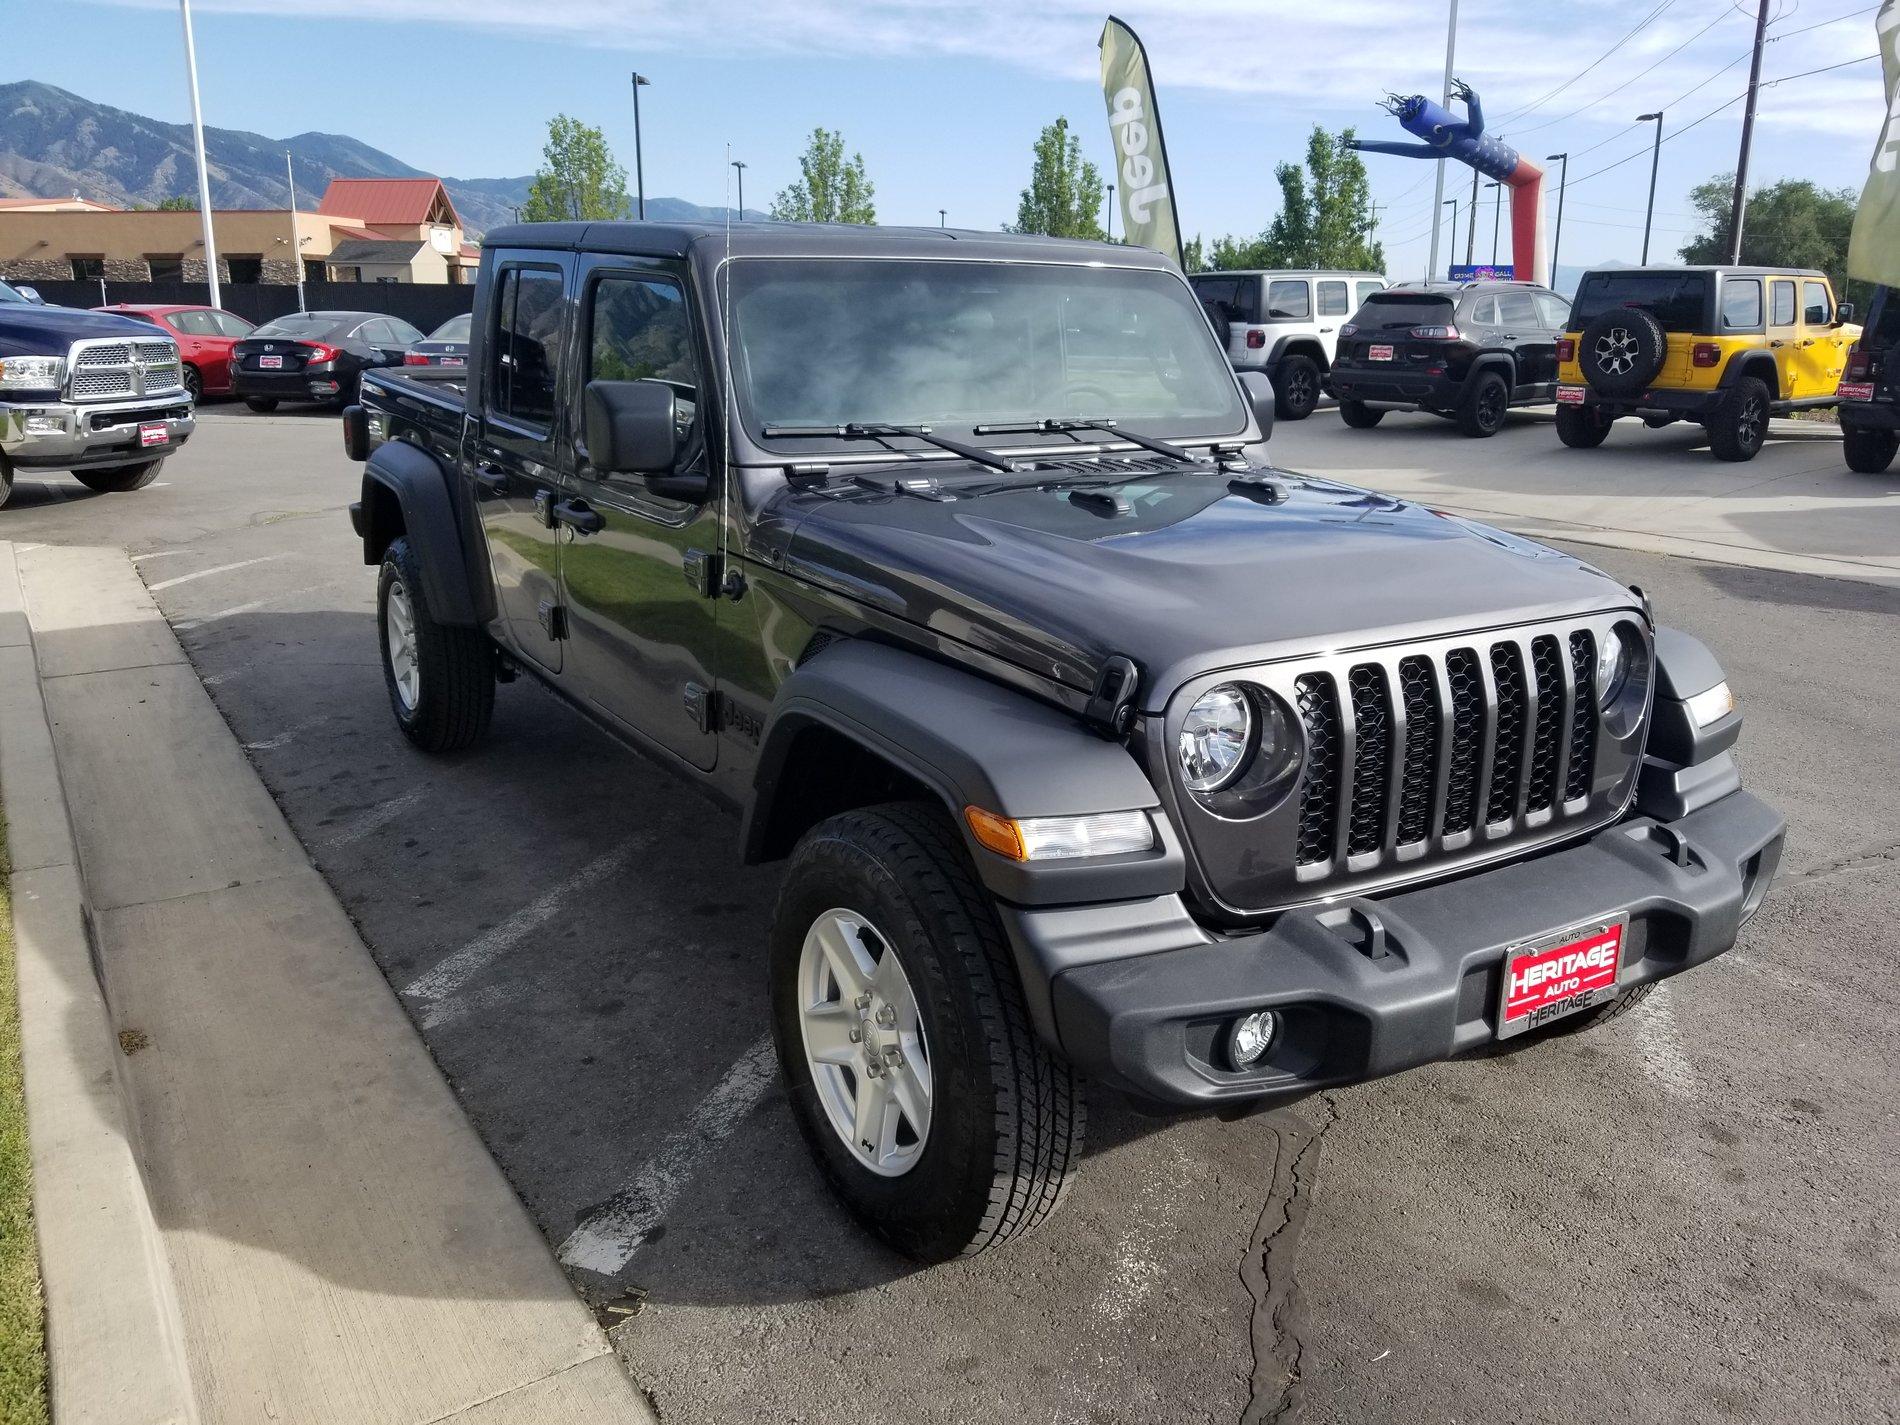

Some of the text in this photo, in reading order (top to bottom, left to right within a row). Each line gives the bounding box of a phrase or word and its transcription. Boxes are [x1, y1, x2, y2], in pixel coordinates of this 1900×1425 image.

[1108, 86, 1168, 225] Jeep
[1840, 386, 1872, 395] HERITAGE
[1559, 931, 1581, 943] AUTO
[1509, 940, 1617, 998] HERITAGE
[1544, 977, 1580, 998] AUTO
[1528, 989, 1594, 1029] HERITAGE
